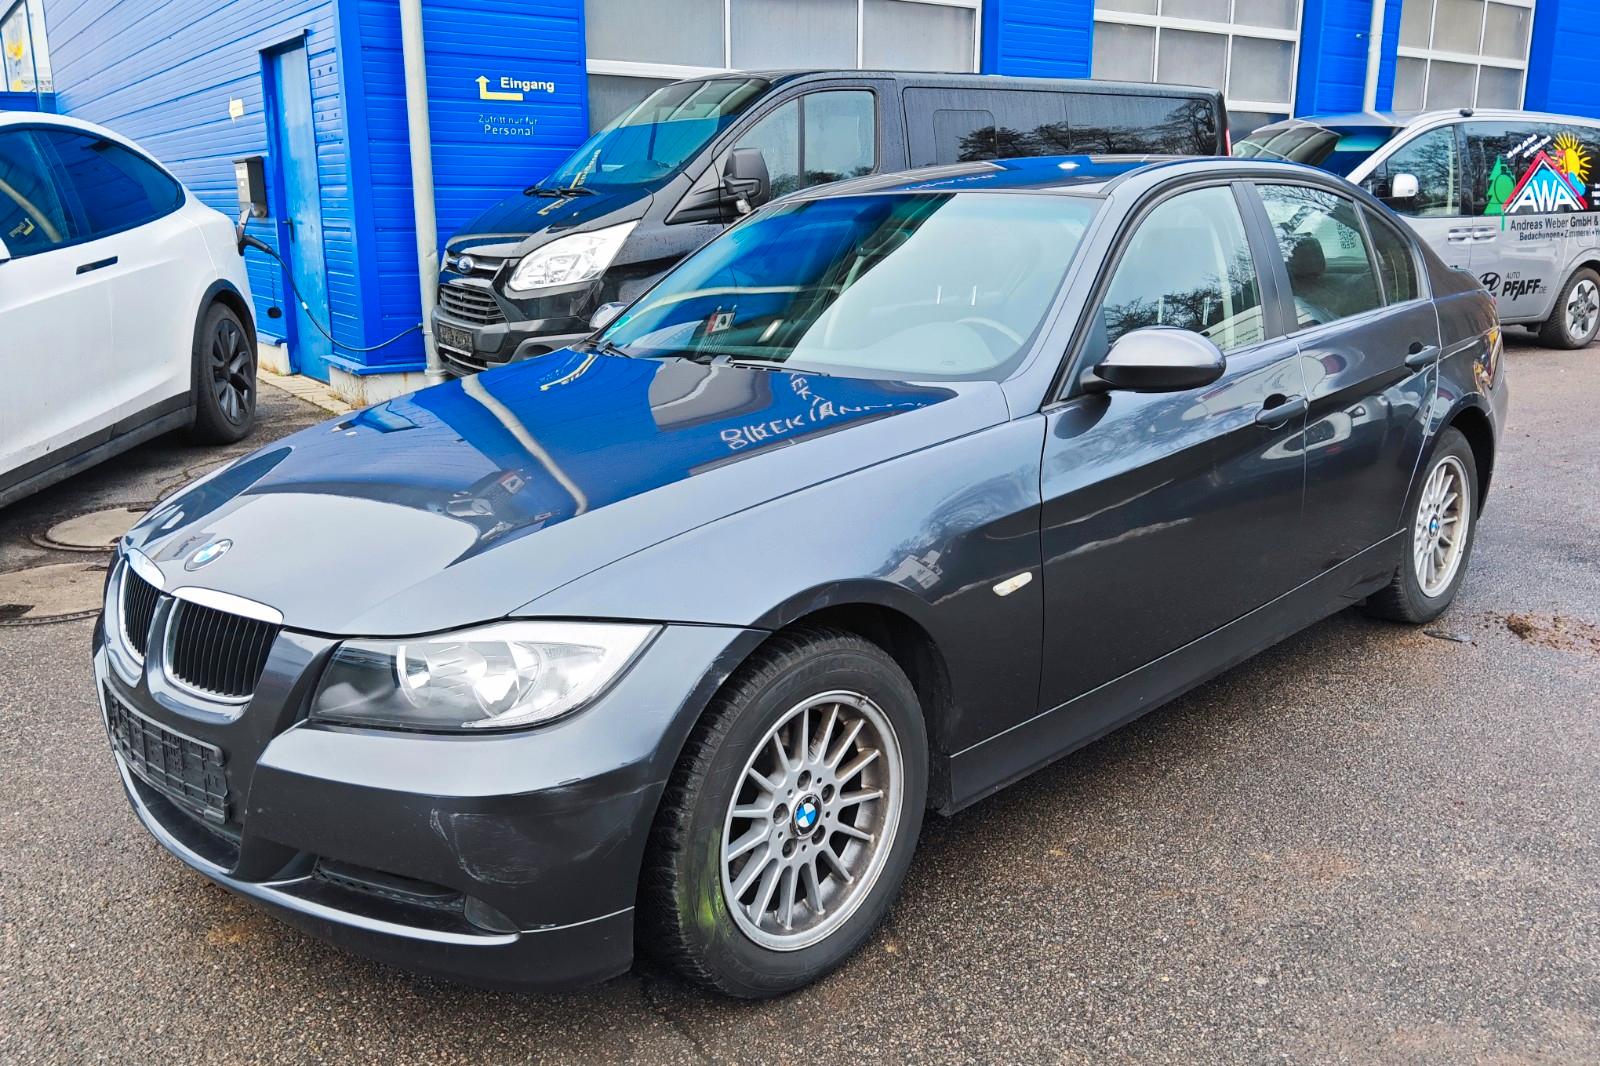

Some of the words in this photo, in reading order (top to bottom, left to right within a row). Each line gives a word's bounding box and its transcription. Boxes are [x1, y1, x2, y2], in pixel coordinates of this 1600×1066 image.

[501, 76, 555, 93] Eingang
[484, 124, 534, 136] Personal
[1509, 180, 1580, 213] AWA
[1511, 219, 1543, 231] Andreas
[1545, 218, 1569, 229] Weber
[1570, 216, 1592, 227] GmbH
[1520, 231, 1559, 241] Bedachungen
[1506, 271, 1521, 280] AUTO
